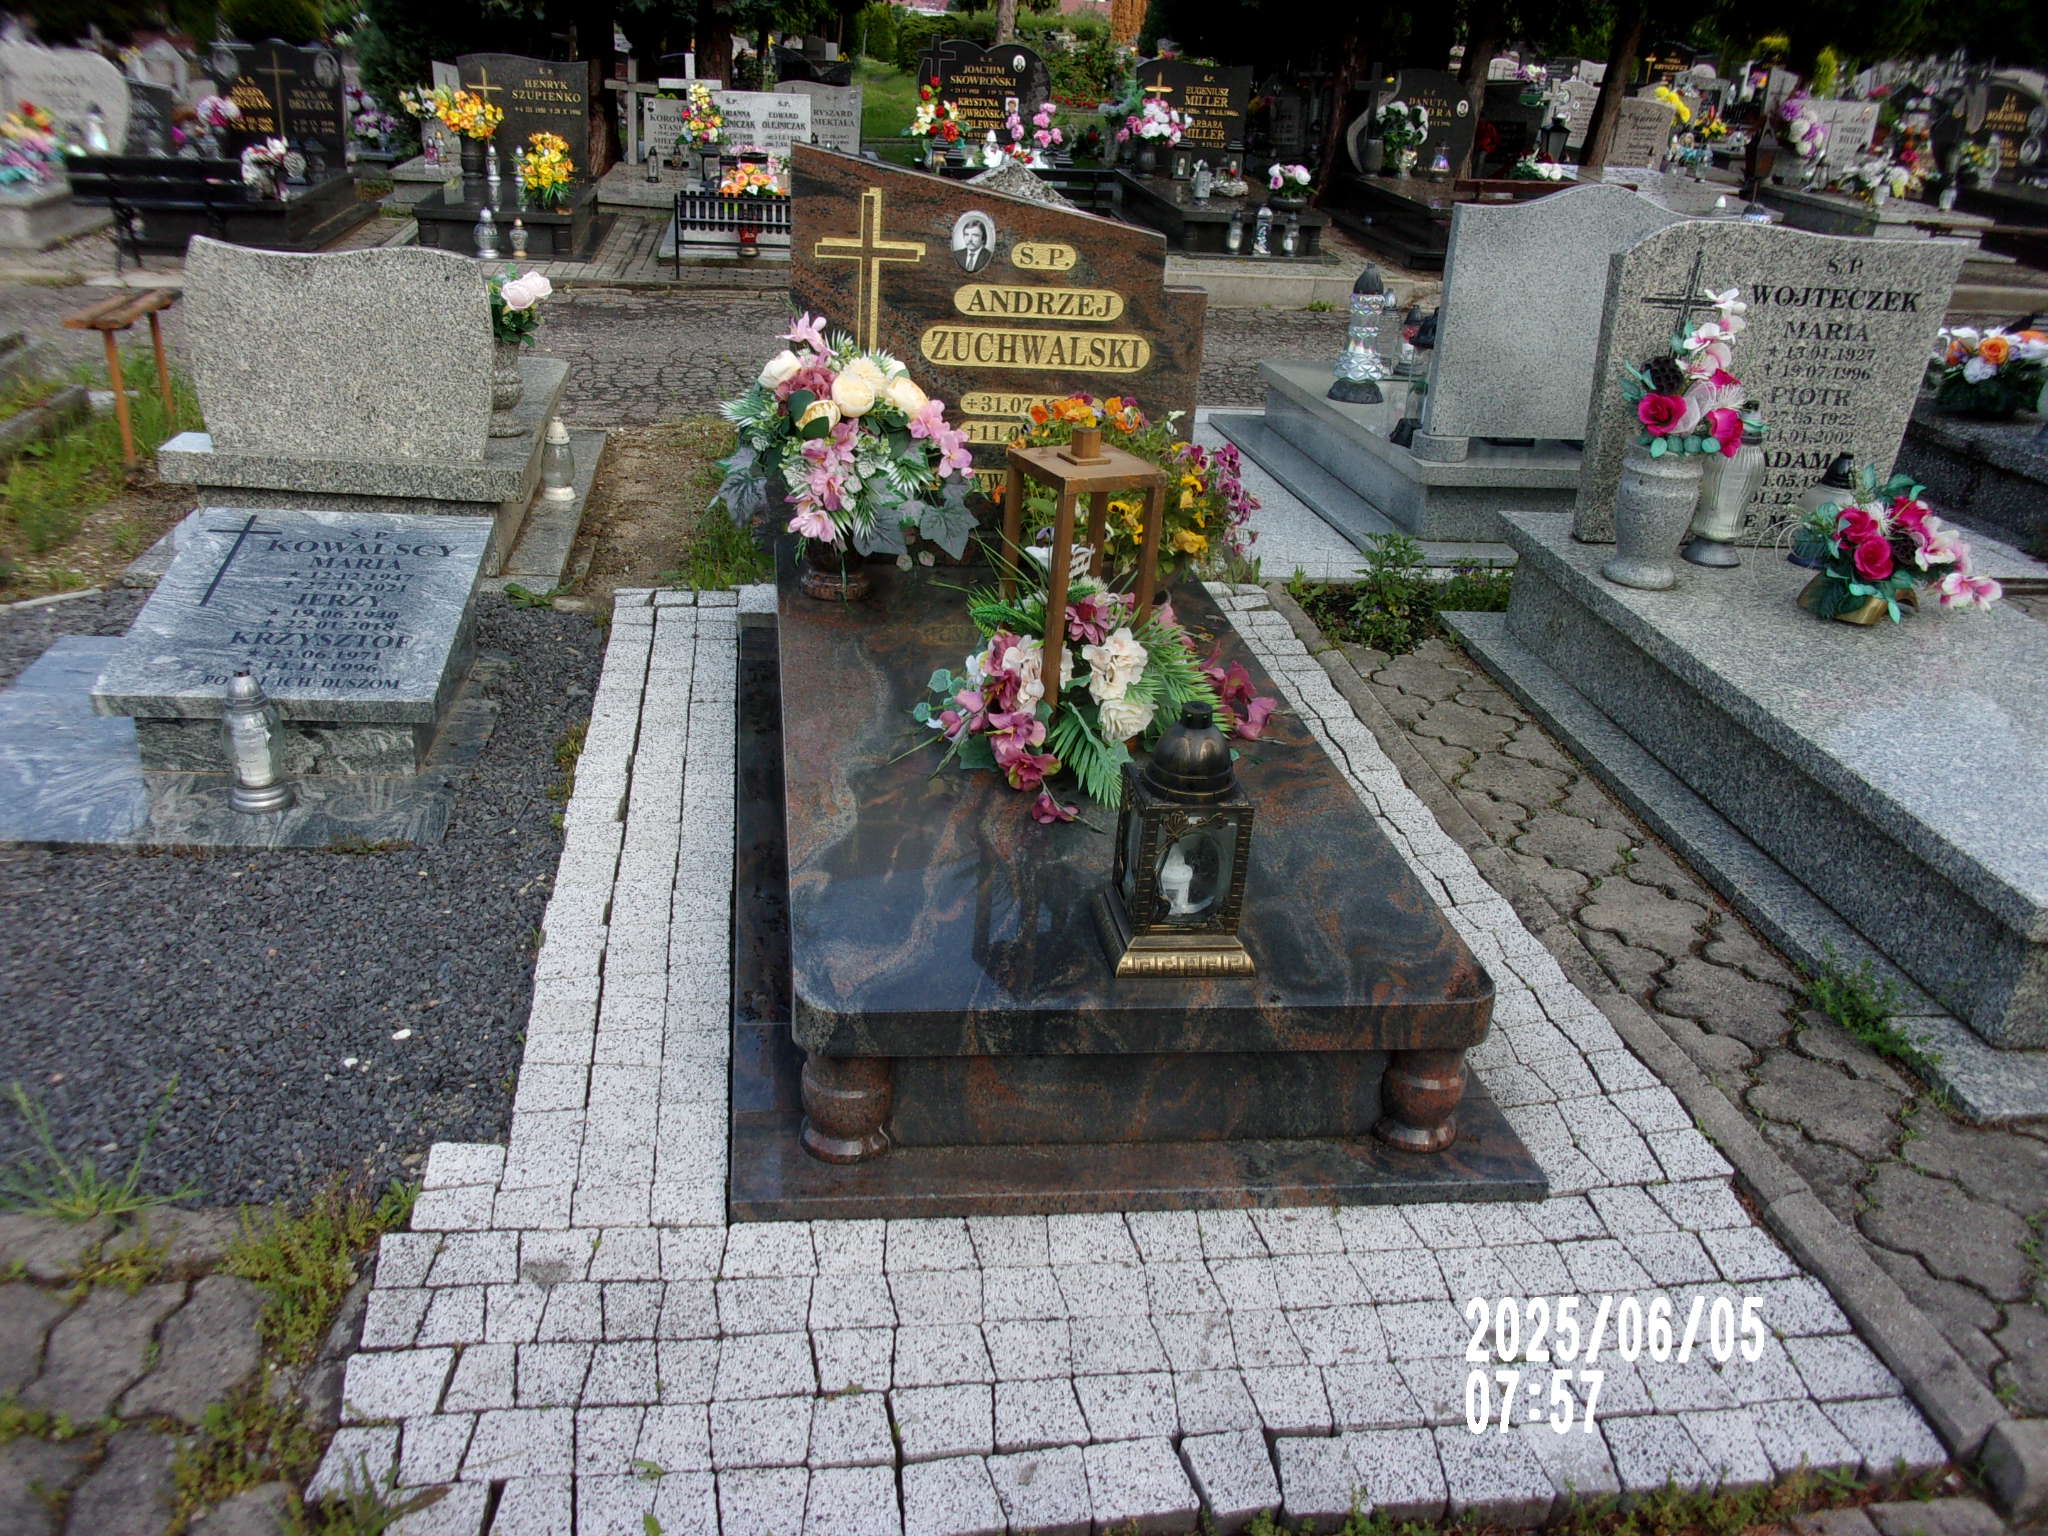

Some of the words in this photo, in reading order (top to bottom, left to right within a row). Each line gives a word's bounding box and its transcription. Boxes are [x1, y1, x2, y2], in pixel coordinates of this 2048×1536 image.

[963, 65, 1005, 75] JOACHIM
[524, 79, 568, 90] HENRYK
[950, 75, 1016, 87] SKOWROŃSKI
[512, 89, 581, 103] SZUPIEŃKO
[1185, 86, 1230, 96] EUGENIUSZ
[958, 97, 999, 107] KRYSTYNA
[1184, 95, 1228, 108] MILLER
[721, 110, 751, 118] ARIANNA
[814, 109, 853, 117] RYSZARD
[959, 107, 1005, 118] OWROŃSKA
[1428, 108, 1452, 118] ORA
[724, 120, 756, 129] JNICZAK
[761, 121, 806, 130] OLEJNICZAK
[967, 119, 1005, 130] SILEWSKA
[1192, 120, 1223, 129] ARBARA
[1047, 247, 1070, 267] P.
[966, 289, 1114, 317] ANDRZEJ
[1752, 285, 1921, 312] WOJTECZEK
[1783, 321, 1869, 342] MARIA
[930, 331, 1143, 368] ZUCHWALSKI
[1768, 386, 1852, 407] PIOTR
[269, 539, 460, 558] KOWALSCY
[308, 556, 401, 570] MARIA
[292, 593, 386, 607] JERZY
[230, 631, 413, 649] KRZYSZTOF
[277, 677, 311, 687] ICH
[321, 678, 400, 690] DUSZOM
